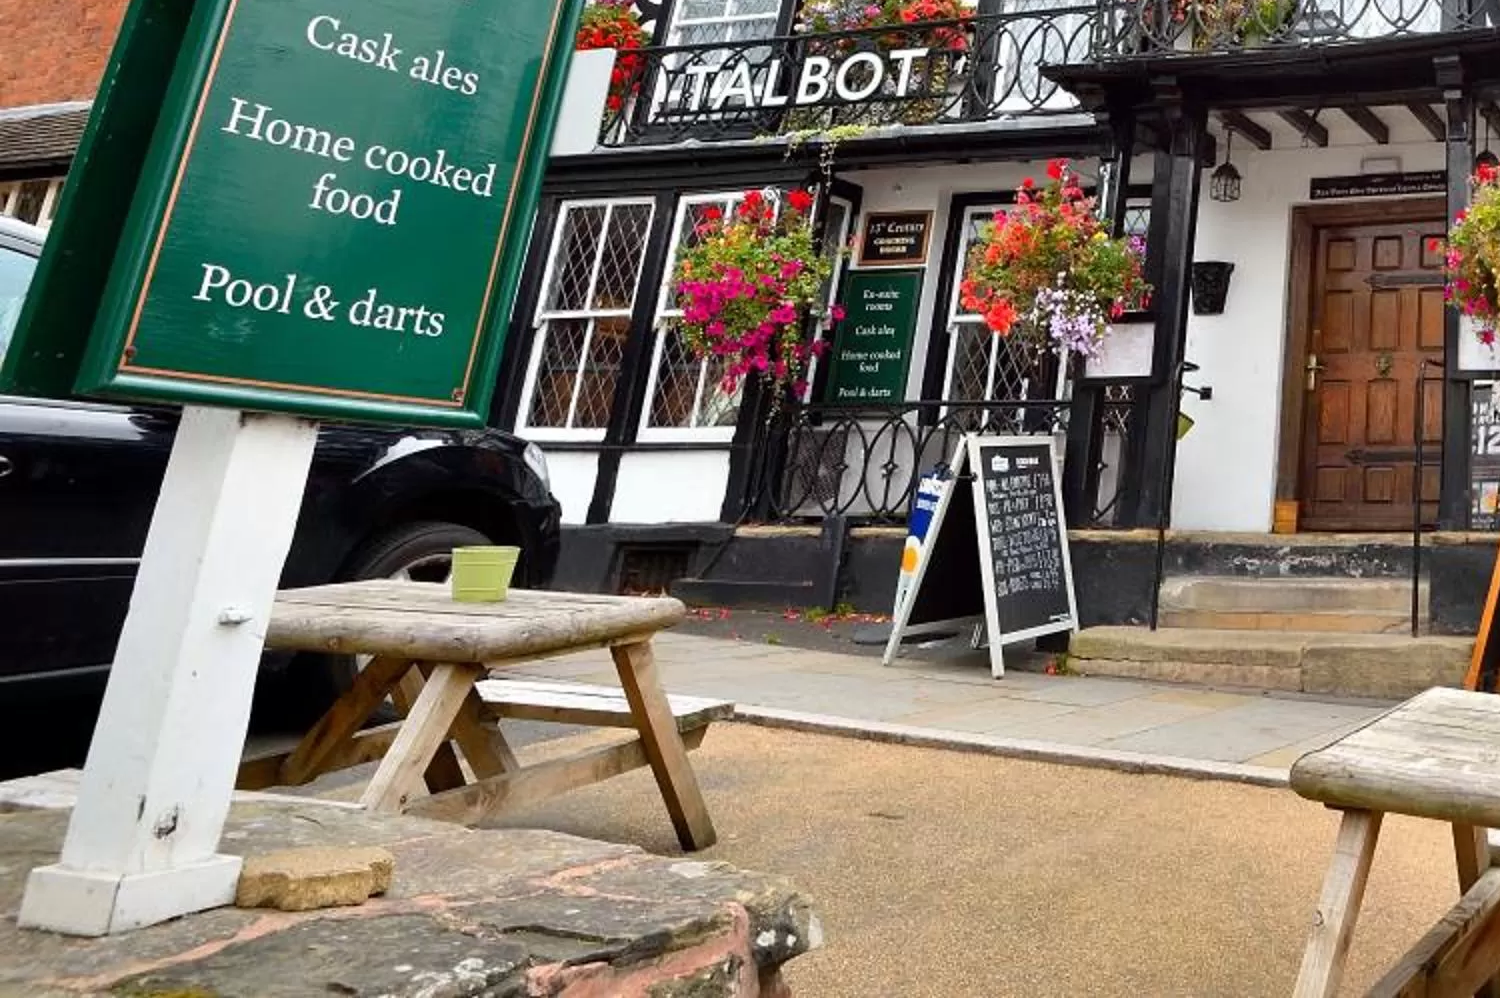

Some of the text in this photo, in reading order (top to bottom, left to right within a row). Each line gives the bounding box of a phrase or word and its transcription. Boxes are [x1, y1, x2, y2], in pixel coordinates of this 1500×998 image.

[306, 15, 480, 95] Cask ales
[687, 48, 928, 109] TALBOT
[221, 97, 498, 198] Home cooked
[309, 175, 402, 225] food
[193, 263, 446, 337] Pool & darts
